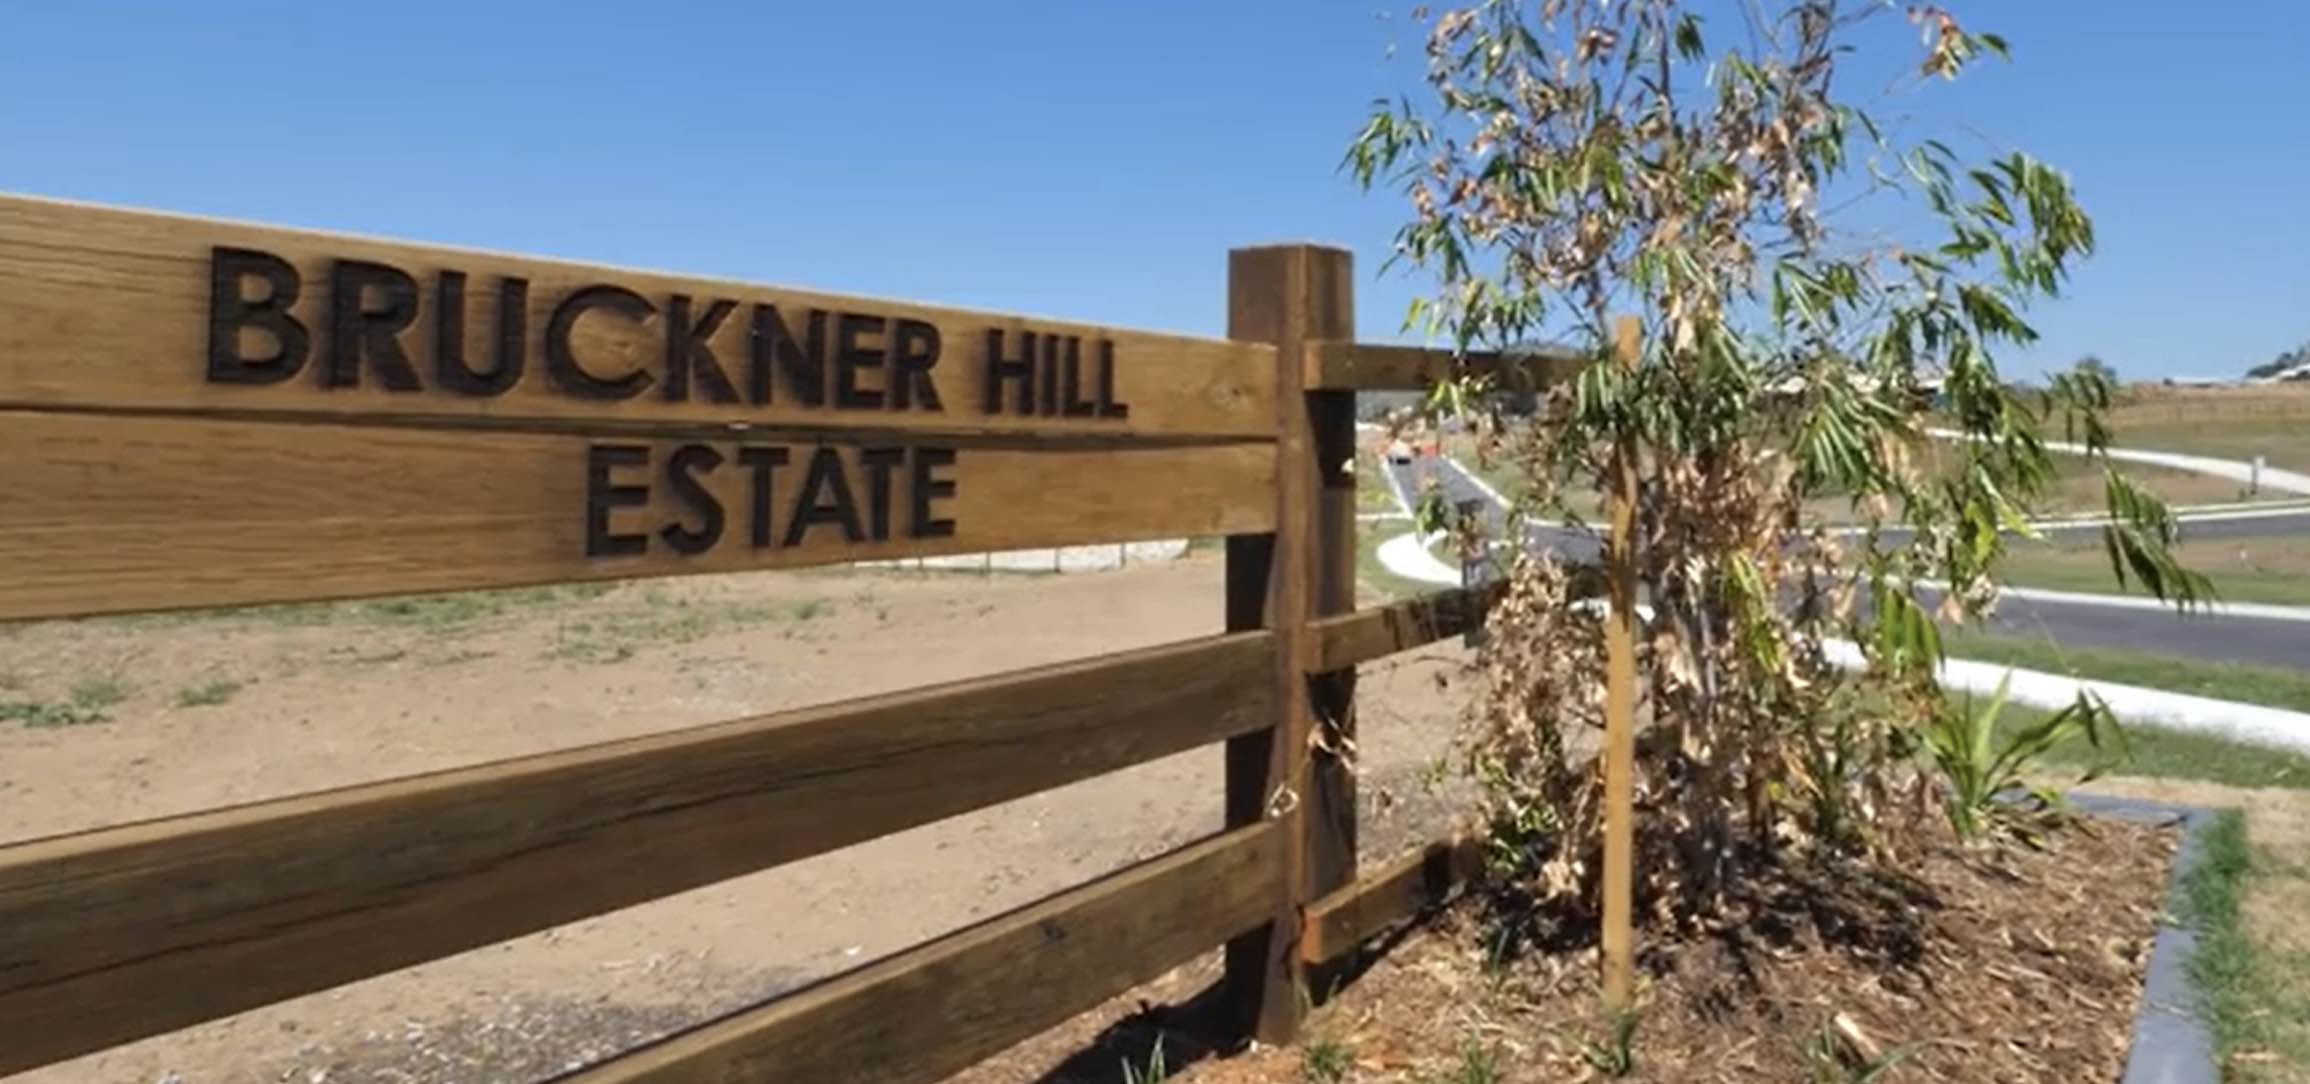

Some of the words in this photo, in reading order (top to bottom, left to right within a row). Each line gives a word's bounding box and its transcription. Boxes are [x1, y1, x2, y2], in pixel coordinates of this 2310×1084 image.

[206, 246, 943, 412] BRUCKNER
[983, 328, 1128, 419] HILL
[586, 444, 956, 557] ESTATE
